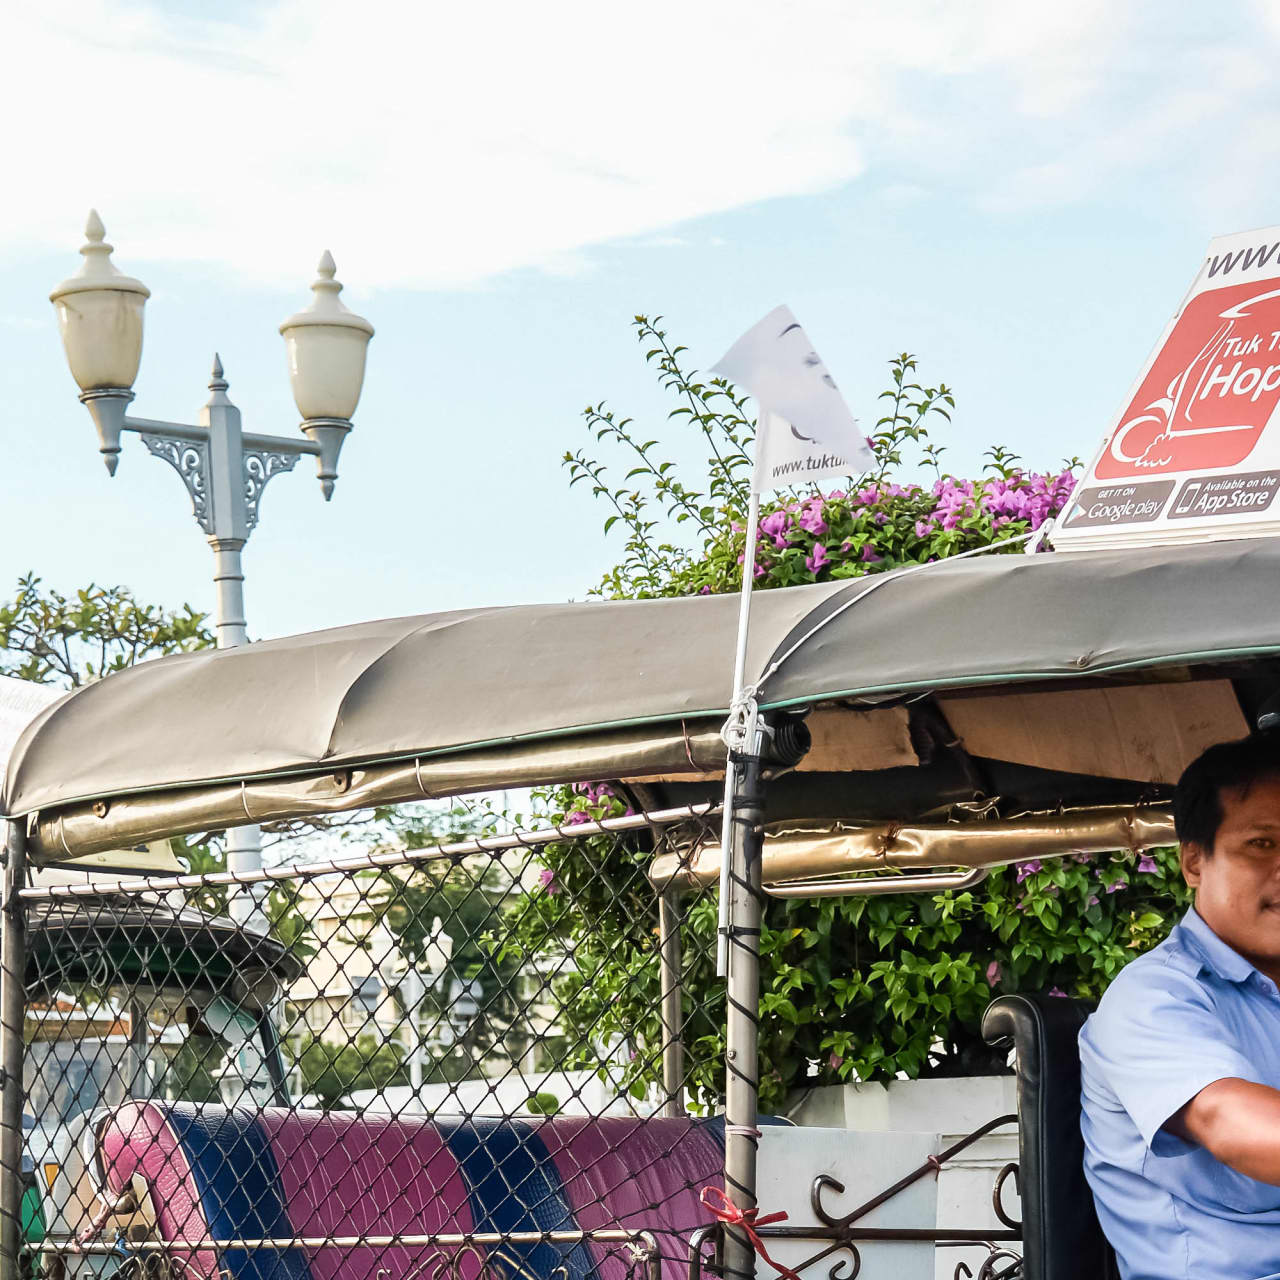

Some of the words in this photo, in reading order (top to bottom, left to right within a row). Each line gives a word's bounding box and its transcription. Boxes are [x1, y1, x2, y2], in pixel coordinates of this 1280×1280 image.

[1224, 333, 1262, 358] Tuk
[1097, 490, 1112, 499] GET
[1122, 487, 1136, 497] ON
[1204, 478, 1245, 493] Available
[1247, 479, 1259, 488] on
[1260, 477, 1277, 488] the
[1088, 501, 1134, 522] Google
[1133, 499, 1163, 517] play
[1194, 493, 1227, 514] App
[1230, 490, 1269, 507] Store
